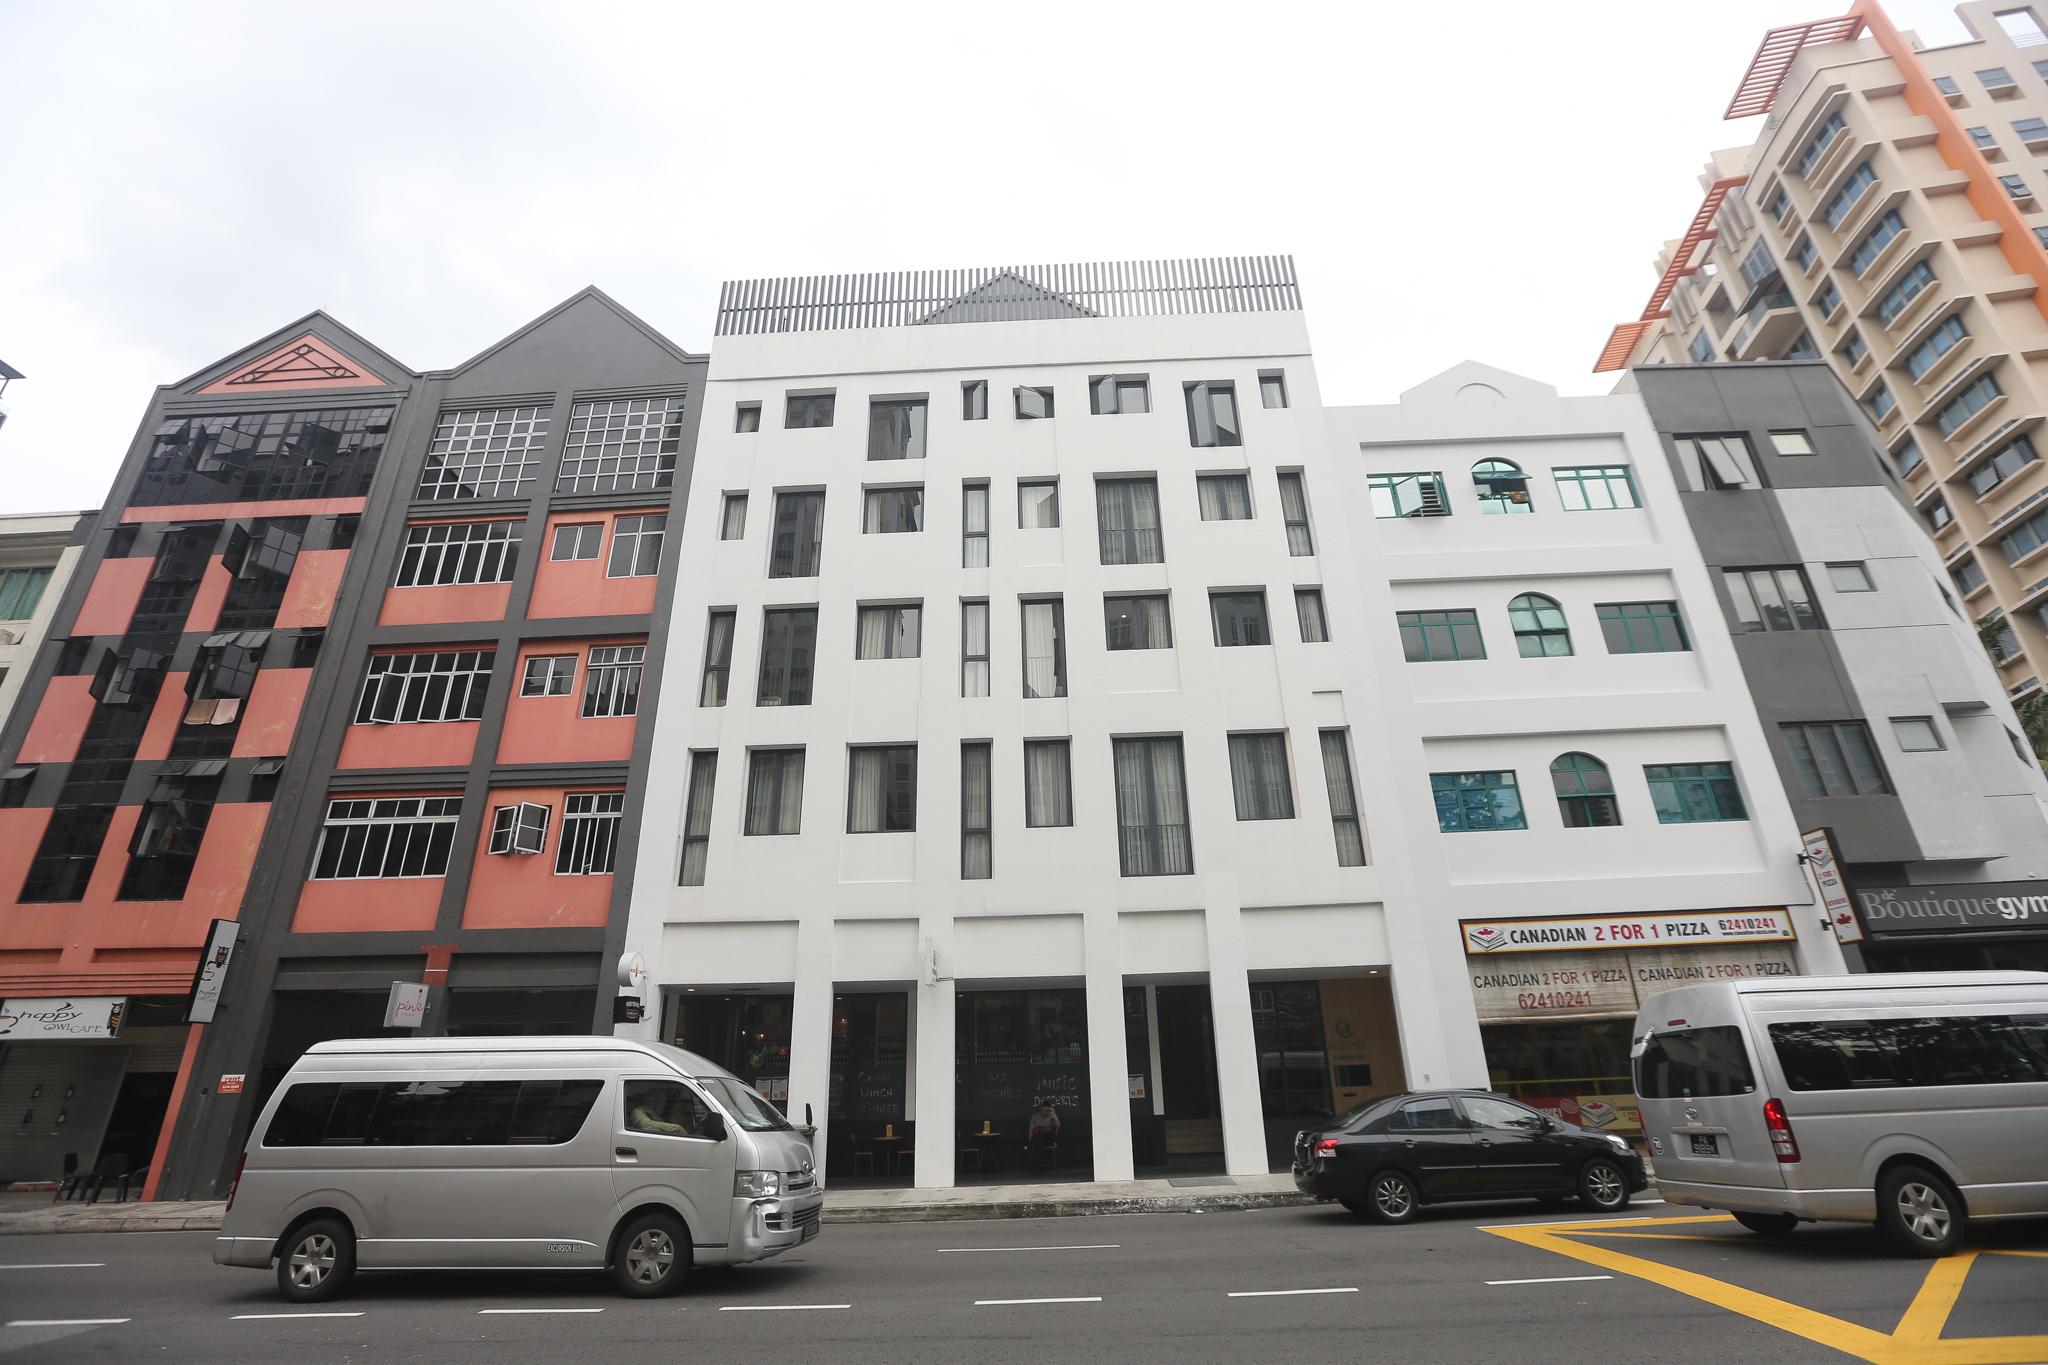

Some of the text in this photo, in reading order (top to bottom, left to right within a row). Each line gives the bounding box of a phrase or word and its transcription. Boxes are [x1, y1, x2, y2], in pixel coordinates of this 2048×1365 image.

[1510, 922, 1711, 944] CANADIAN 2 FOR 1 PIZZA
[1718, 918, 1776, 931] 62410241
[1473, 969, 1628, 988] CANADIAN 2 FOR 1 PIZZA
[1638, 961, 1793, 982] CANADIAN 2 FOR 1 PIZZA
[1518, 990, 1592, 1009] 62410241
